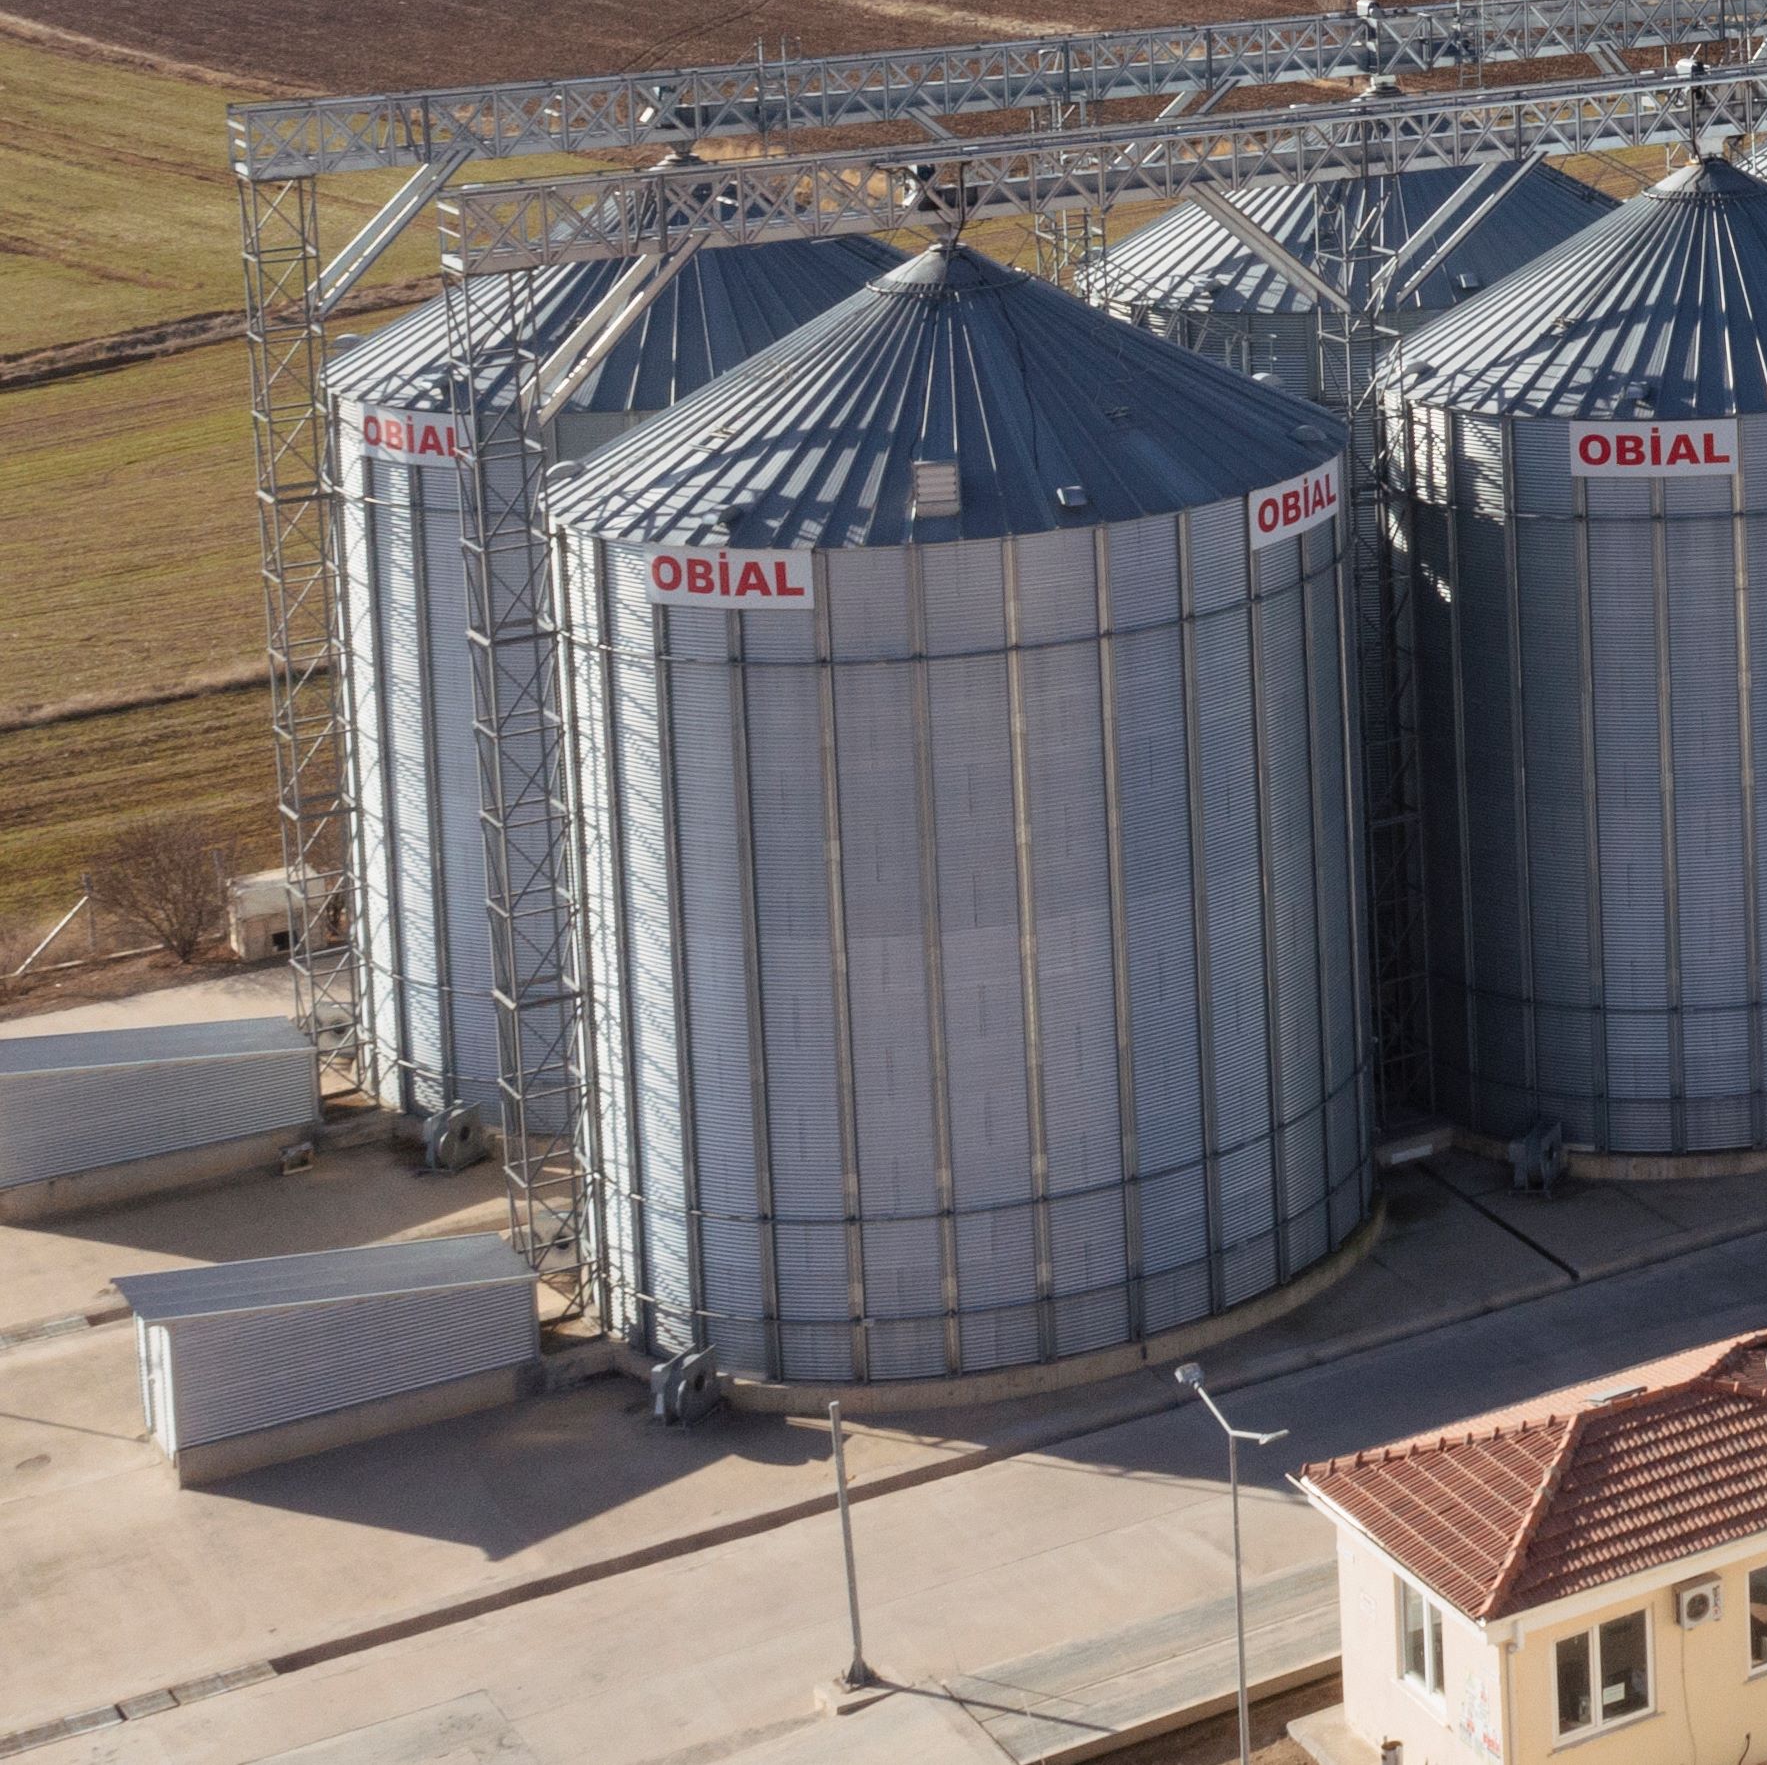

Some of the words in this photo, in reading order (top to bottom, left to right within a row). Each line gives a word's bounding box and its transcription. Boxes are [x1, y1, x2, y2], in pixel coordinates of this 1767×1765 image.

[1578, 426, 1730, 466] OBİAL
[1258, 473, 1336, 533] OBİAL
[651, 550, 805, 597] OBİAL
